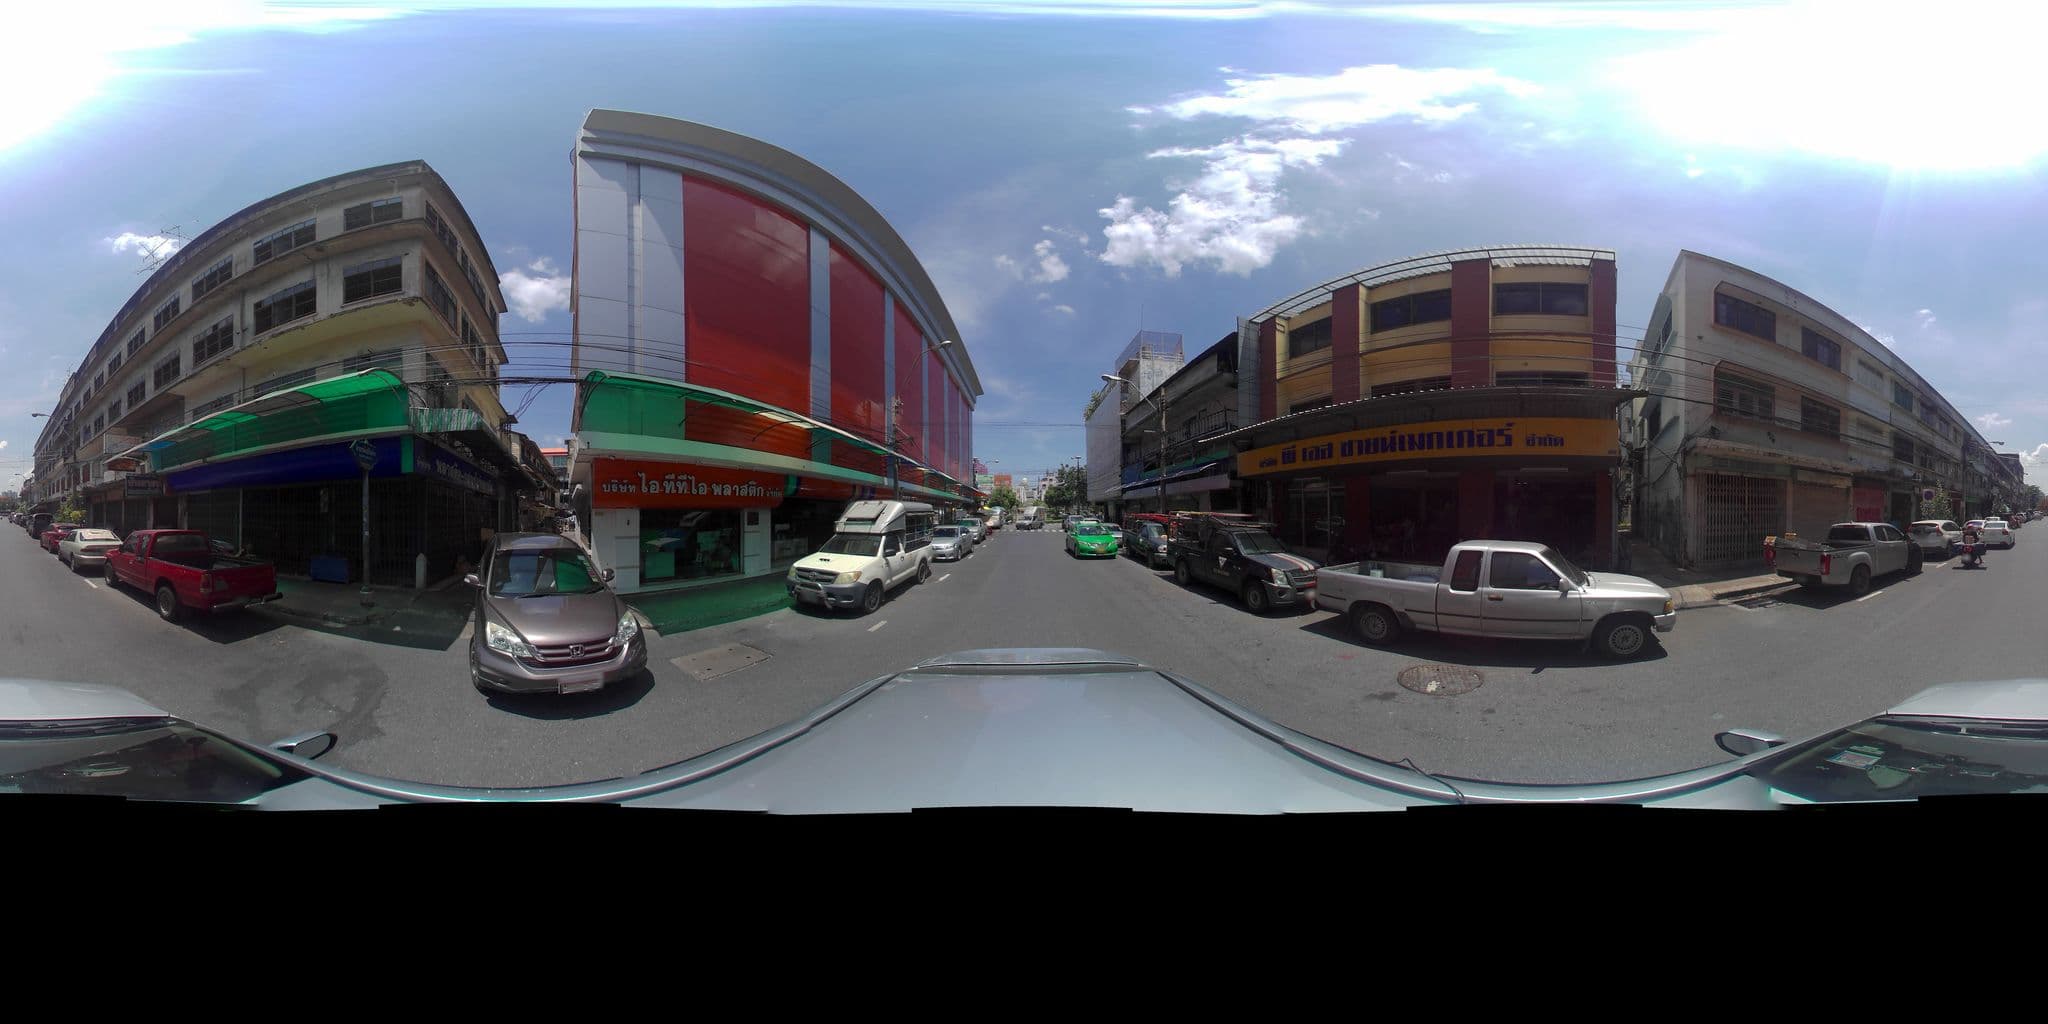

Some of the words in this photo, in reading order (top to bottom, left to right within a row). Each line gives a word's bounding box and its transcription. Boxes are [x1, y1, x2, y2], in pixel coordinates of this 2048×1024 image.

[601, 479, 637, 493] บริษัท
[711, 480, 764, 497] พลาสติก
